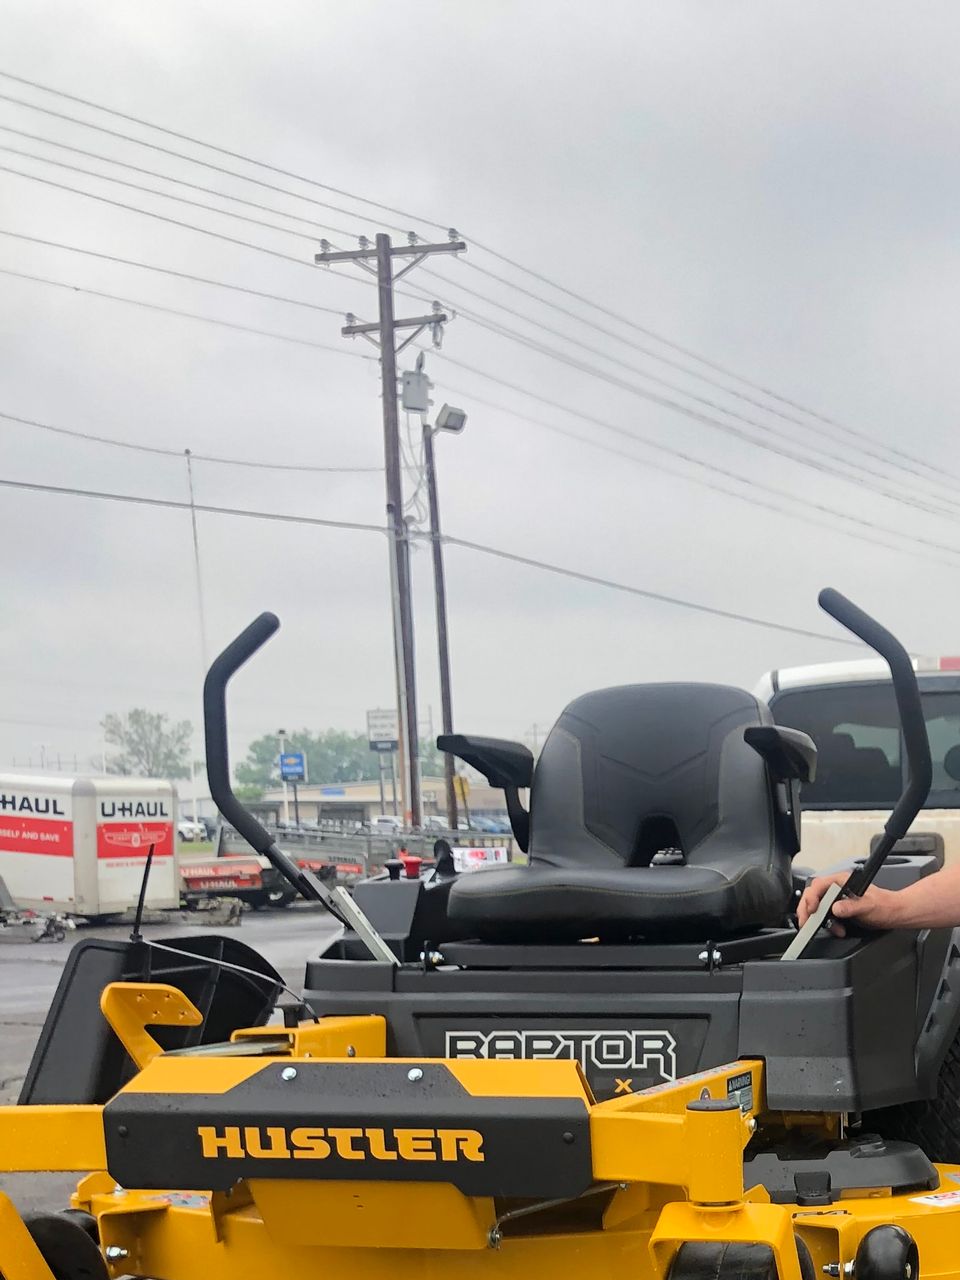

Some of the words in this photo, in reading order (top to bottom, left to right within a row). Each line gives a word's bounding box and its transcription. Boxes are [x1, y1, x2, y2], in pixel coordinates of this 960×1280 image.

[101, 802, 168, 817] U-HAUL
[22, 831, 39, 841] AND
[445, 1030, 676, 1081] RAPTOR
[198, 1126, 485, 1161] HUSTLER
